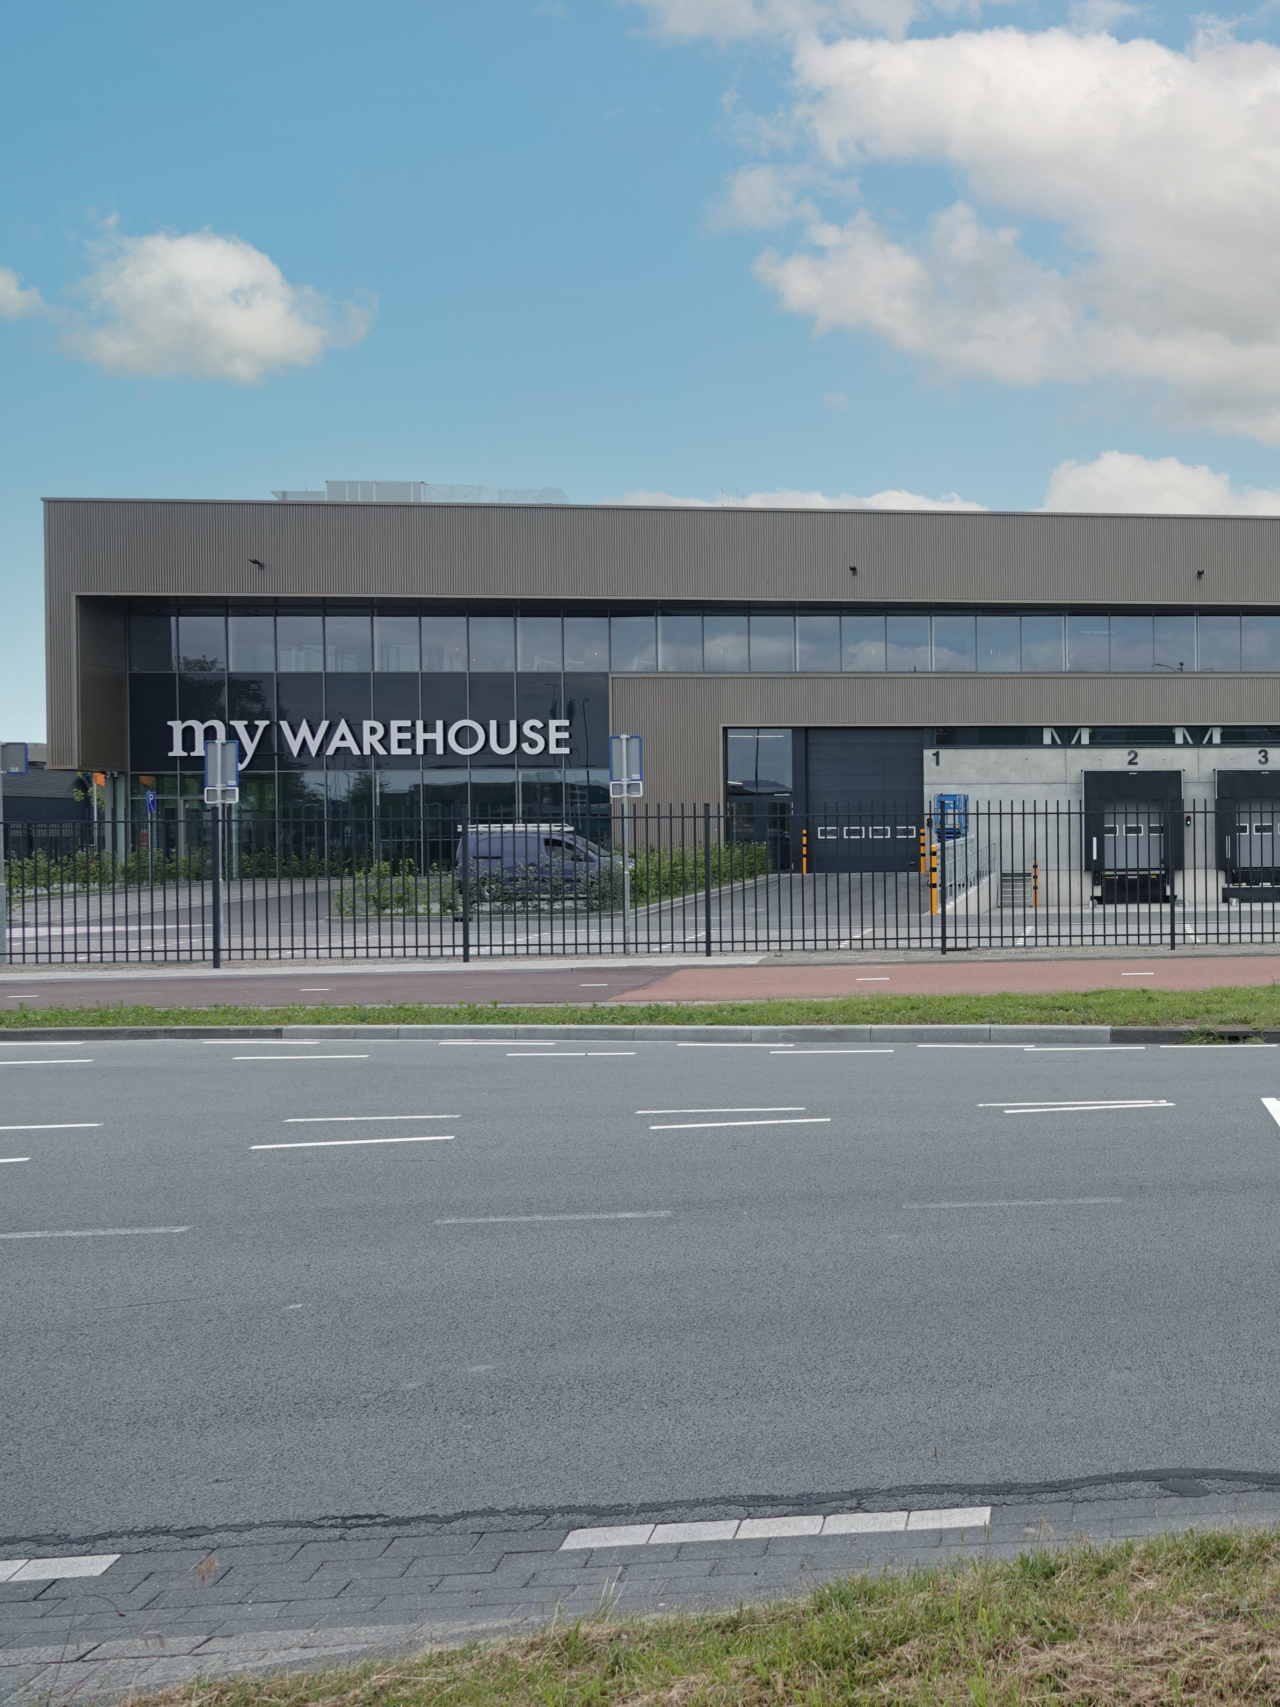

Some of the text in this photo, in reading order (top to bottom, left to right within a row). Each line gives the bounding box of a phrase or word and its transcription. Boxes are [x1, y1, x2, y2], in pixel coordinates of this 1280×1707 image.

[167, 718, 570, 771] my WAREHOUSE
[932, 750, 940, 766] 1
[1127, 749, 1138, 766] 2
[1257, 749, 1268, 765] 3
